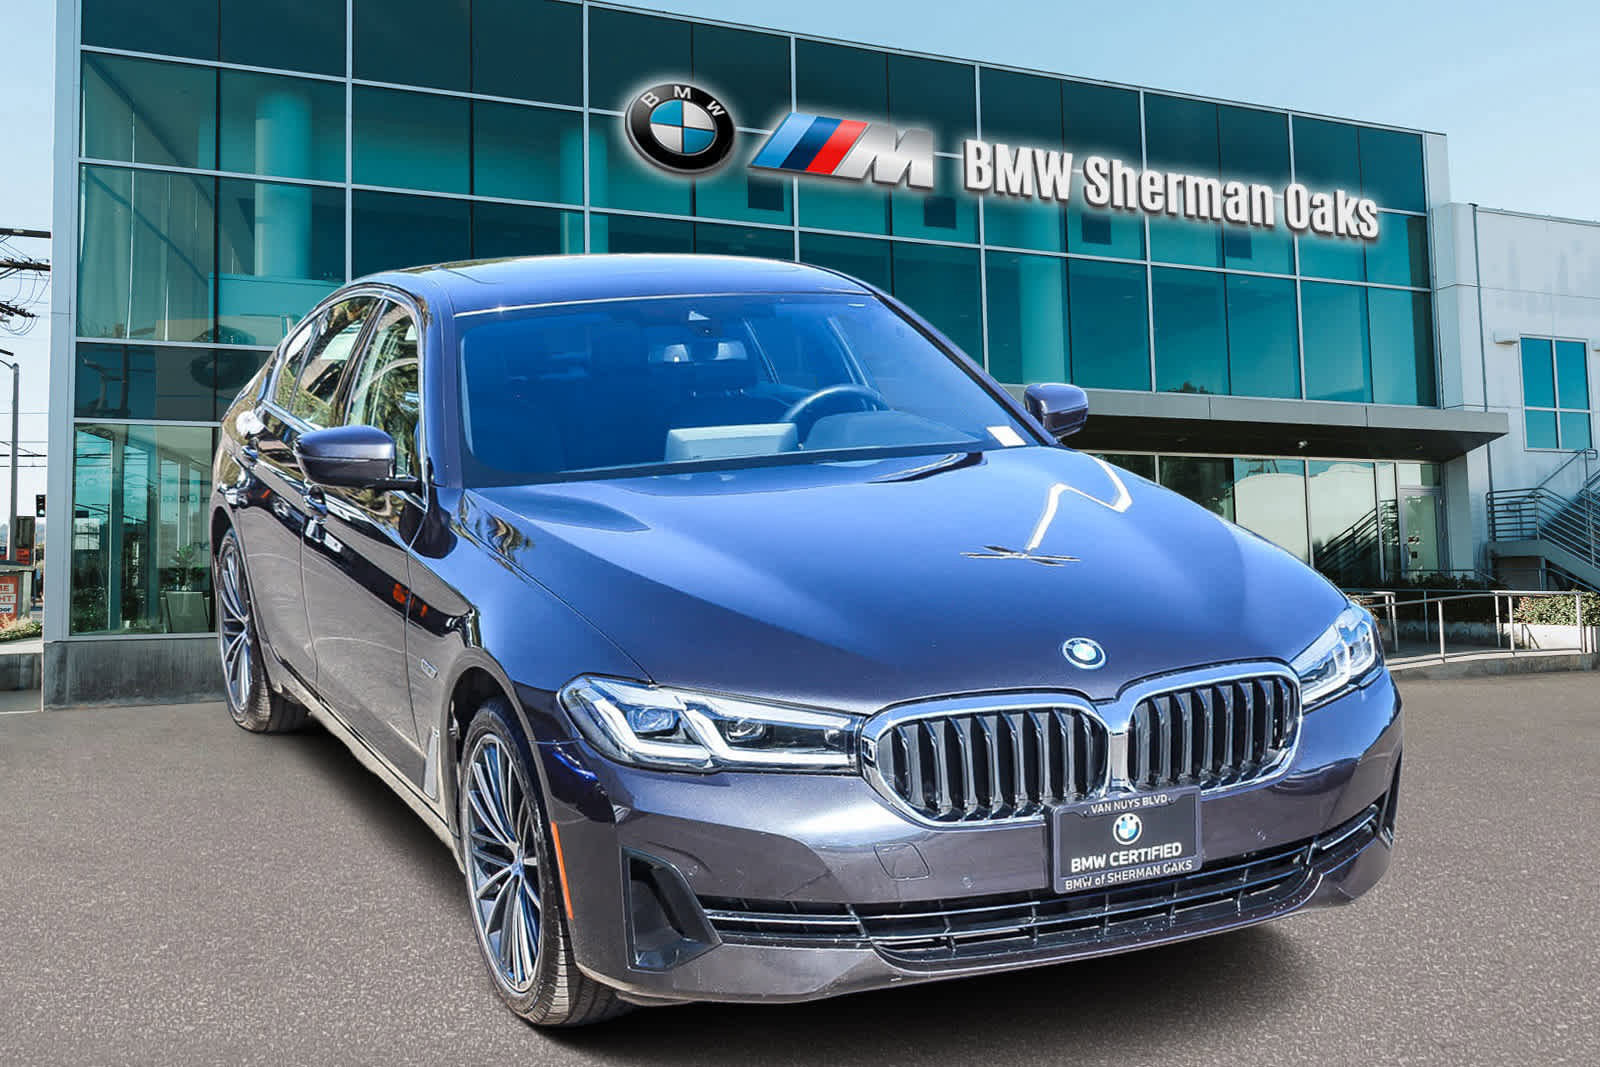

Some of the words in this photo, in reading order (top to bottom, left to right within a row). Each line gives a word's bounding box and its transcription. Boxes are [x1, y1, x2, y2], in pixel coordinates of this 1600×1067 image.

[641, 85, 725, 117] BMW
[833, 123, 934, 190] M
[964, 139, 1073, 200] BMW
[1083, 156, 1274, 227] Sherman
[1283, 183, 1378, 239] Oaks
[1091, 804, 1112, 814] VAN
[1114, 798, 1140, 810] NUYS
[1071, 854, 1106, 873] BMW
[1109, 842, 1182, 866] CERTIFIED
[1065, 876, 1092, 890] BMW
[1095, 874, 1106, 886] of
[1107, 865, 1160, 883] SHERMAN
[1163, 860, 1192, 873] OAKS
